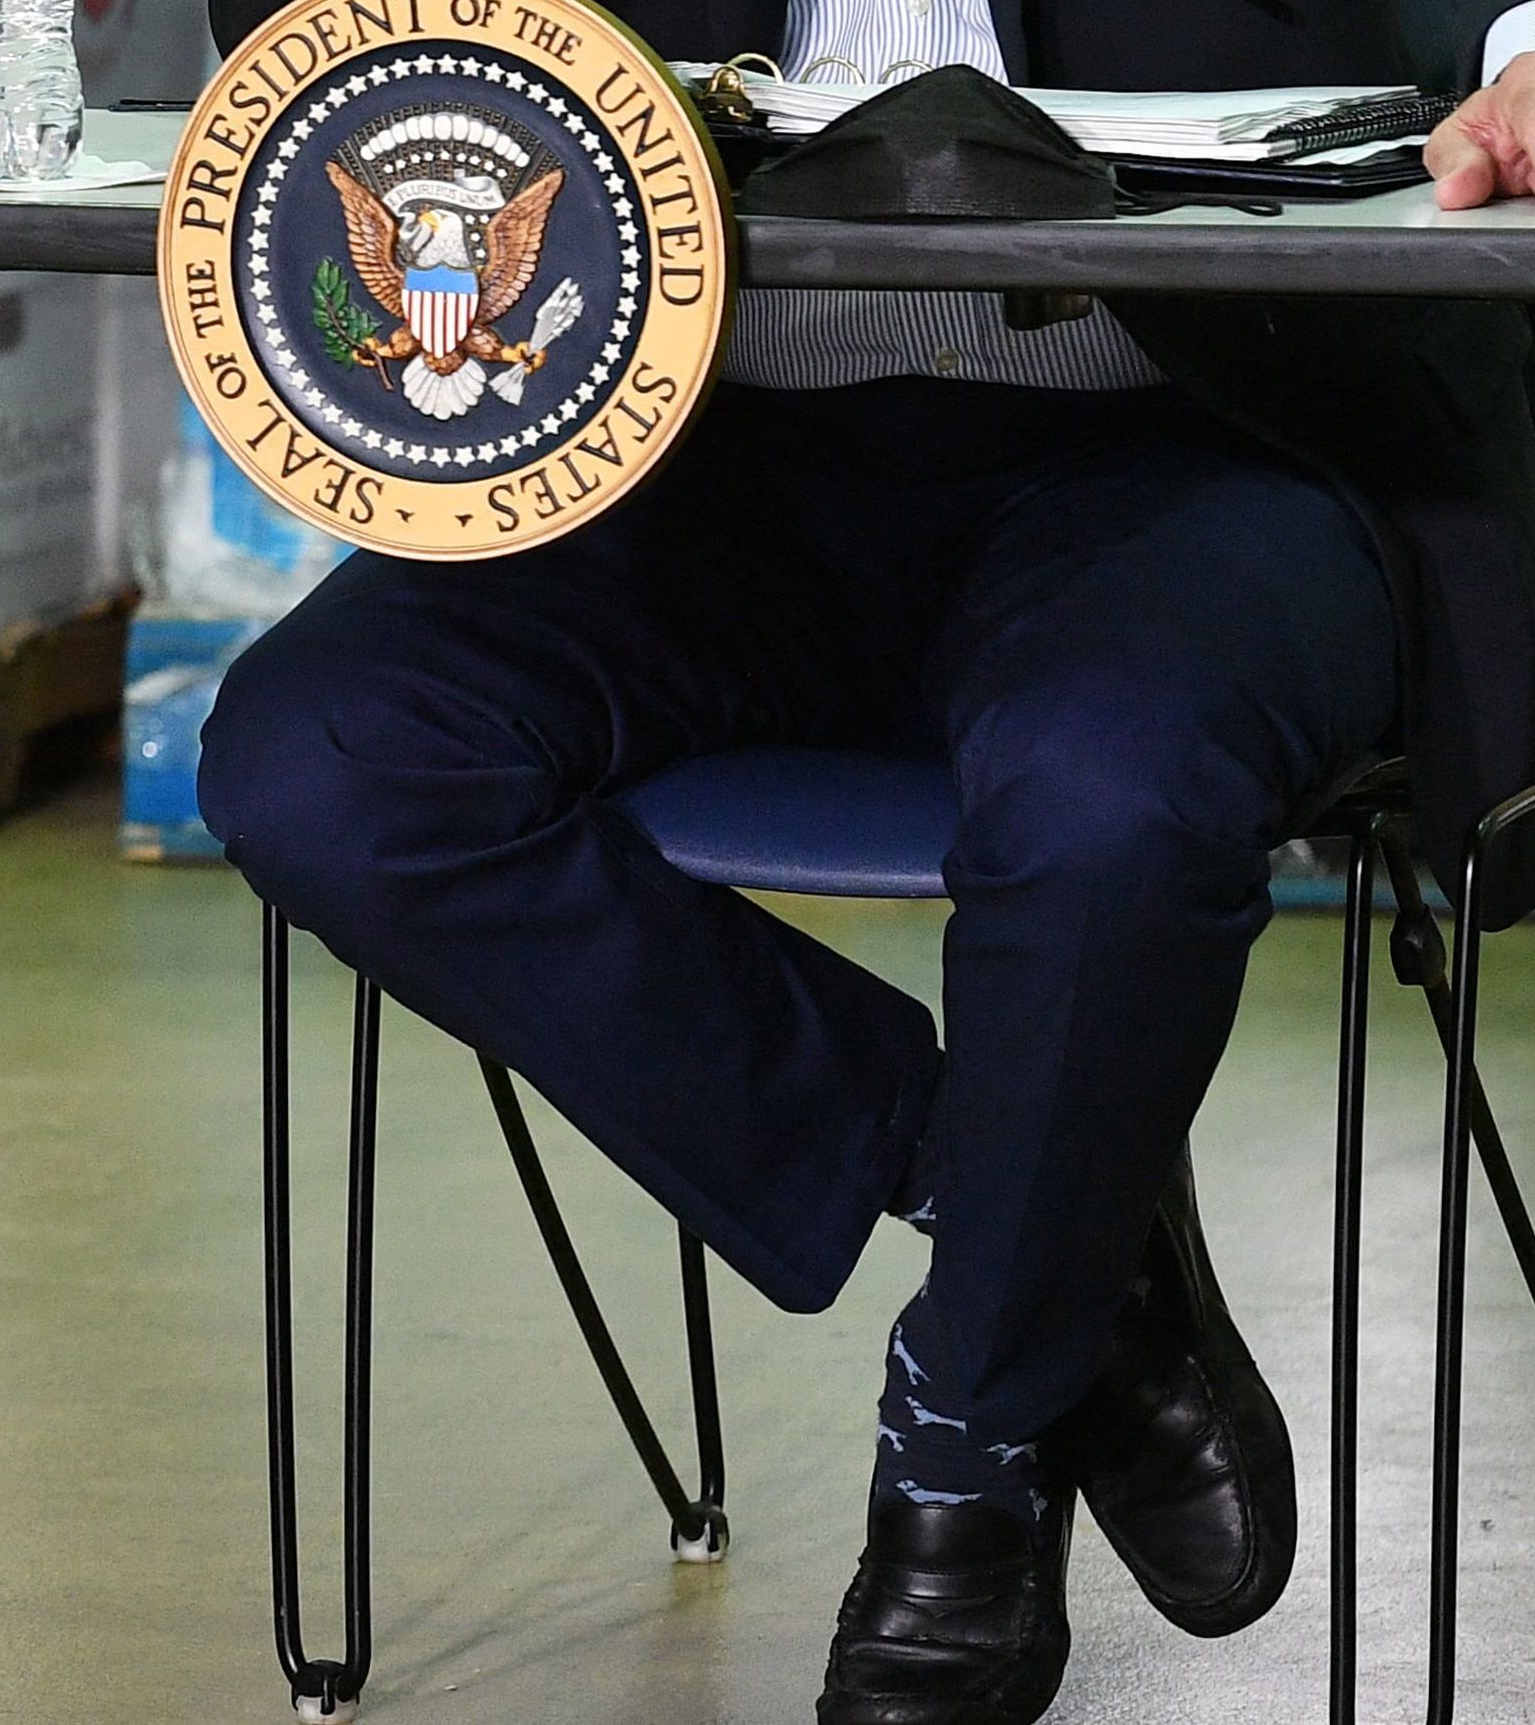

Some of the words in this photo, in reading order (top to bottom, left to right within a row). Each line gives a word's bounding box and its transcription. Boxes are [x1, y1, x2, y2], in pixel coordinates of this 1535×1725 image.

[514, 6, 583, 66] THE
[398, 184, 457, 205] PLURIBUS
[596, 62, 705, 306] UNITED
[186, 259, 224, 339] THE
[205, 351, 248, 400] OF
[246, 400, 385, 524] SEAL
[487, 361, 678, 533] STATES
